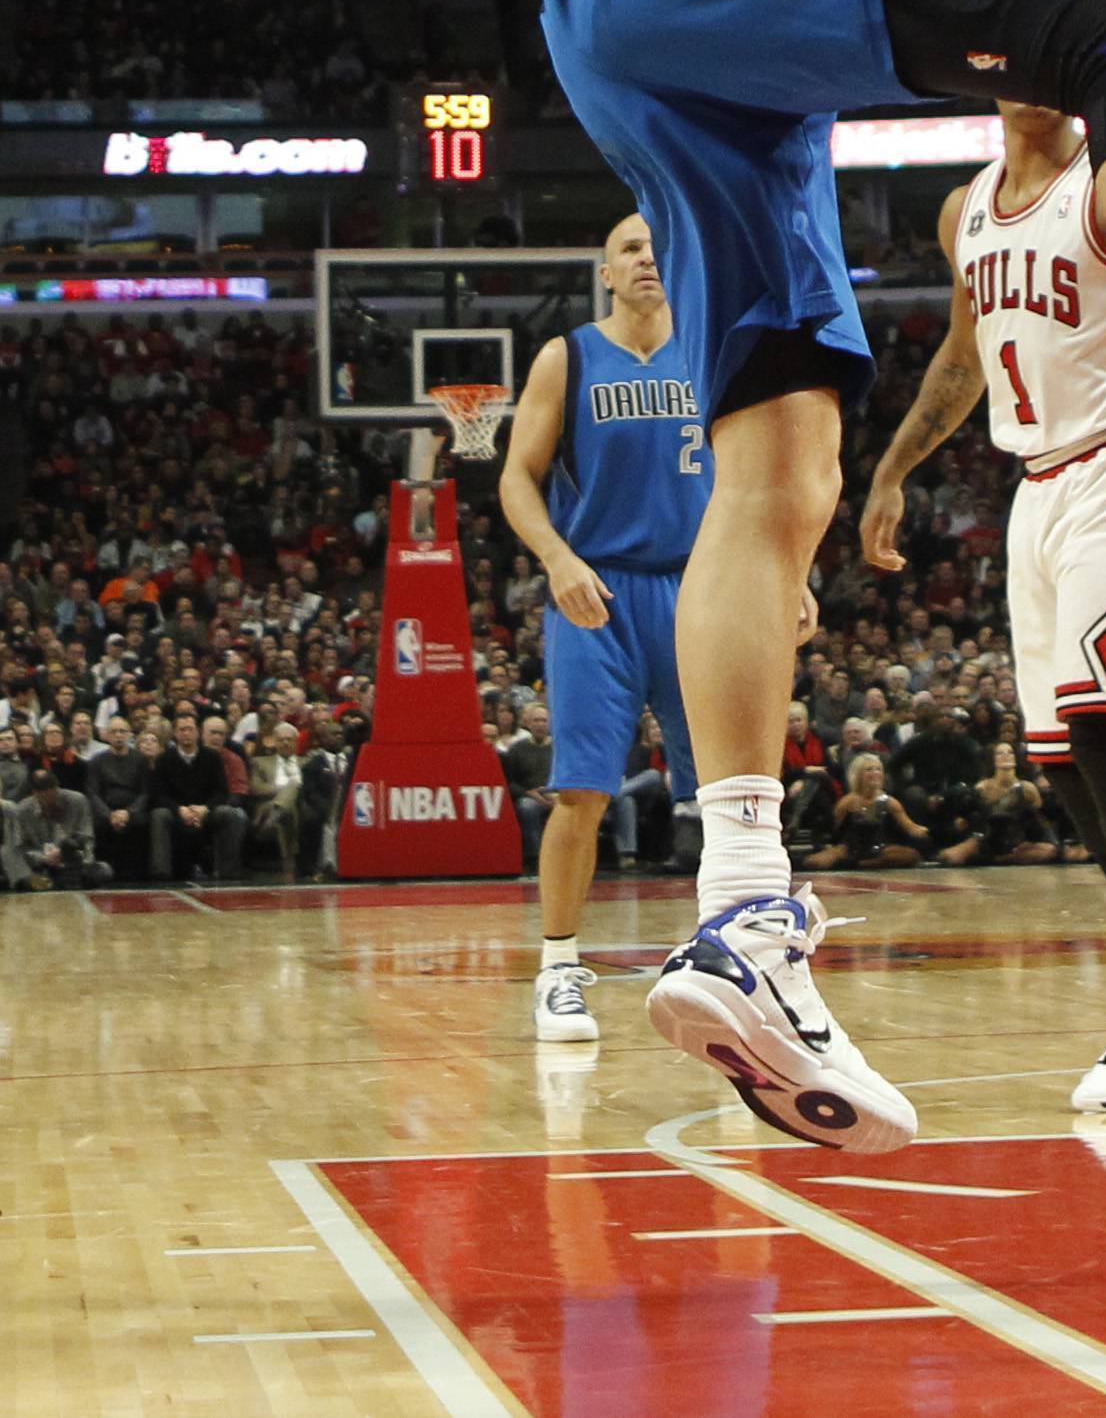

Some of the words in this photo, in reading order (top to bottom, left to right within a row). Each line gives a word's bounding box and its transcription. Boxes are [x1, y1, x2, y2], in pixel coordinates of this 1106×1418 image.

[430, 130, 482, 179] 10
[590, 379, 700, 424] DALLAS
[999, 339, 1038, 425] 1
[679, 424, 704, 475] 2
[389, 786, 457, 821] NBA
[460, 785, 504, 820] TV
